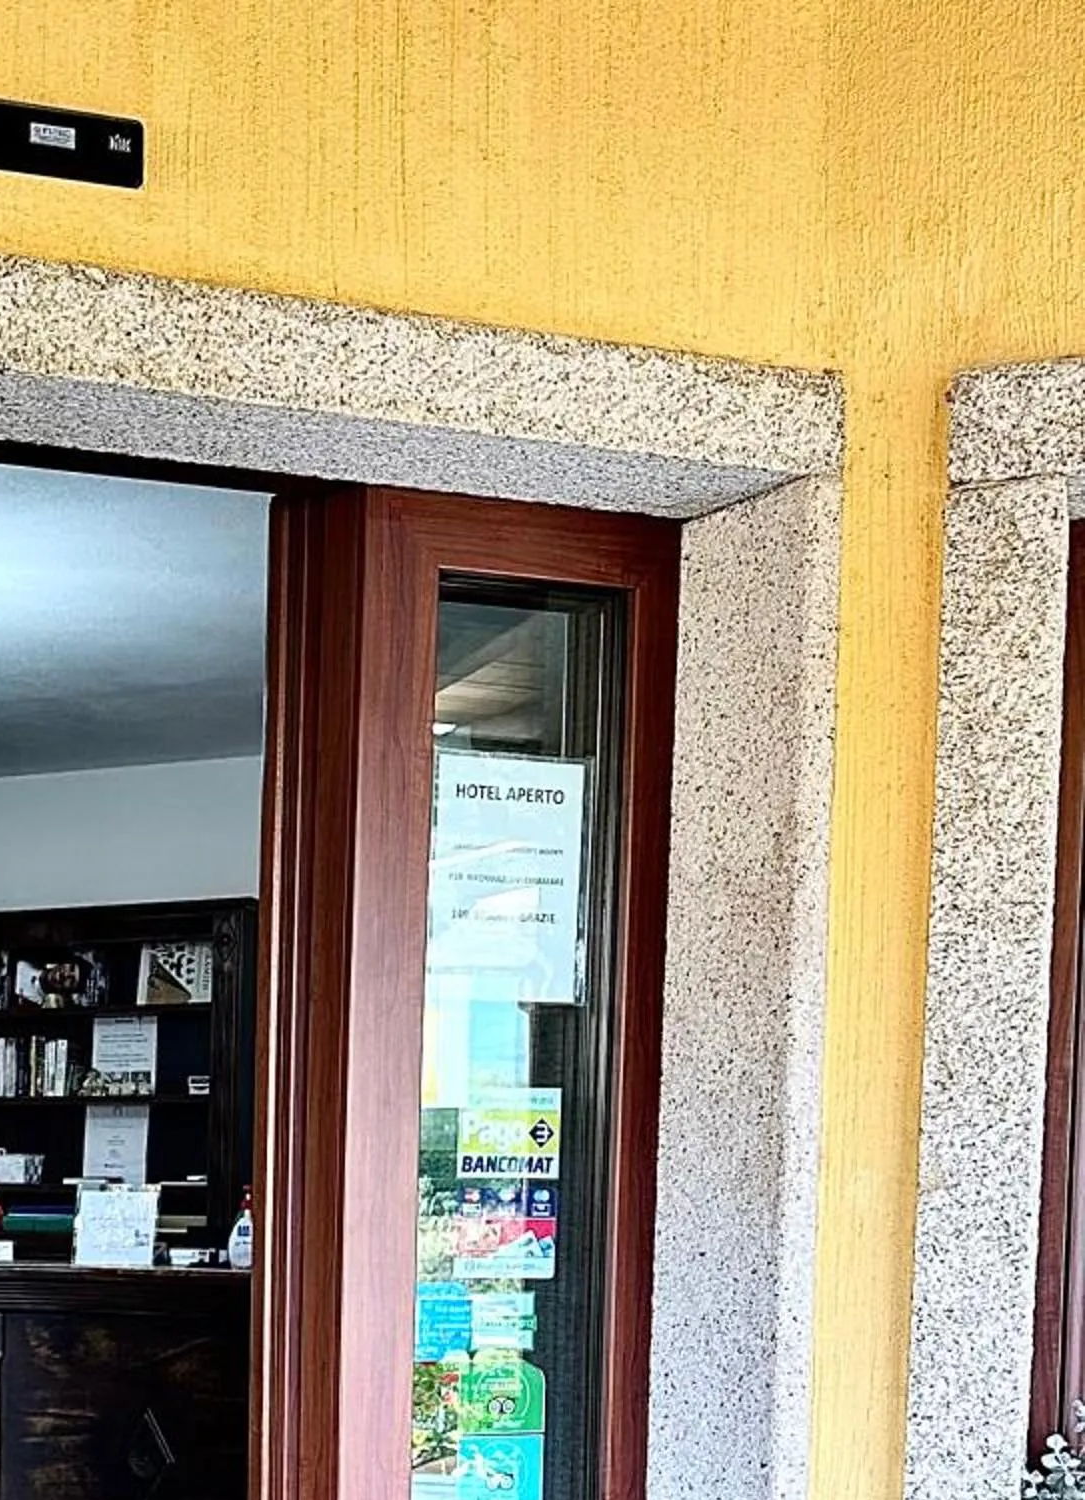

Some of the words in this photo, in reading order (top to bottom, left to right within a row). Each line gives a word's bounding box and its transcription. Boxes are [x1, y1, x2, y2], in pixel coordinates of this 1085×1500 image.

[455, 783, 502, 801] HOTEL
[505, 787, 566, 805] APERTO
[461, 1155, 554, 1174] BANCOMAT
